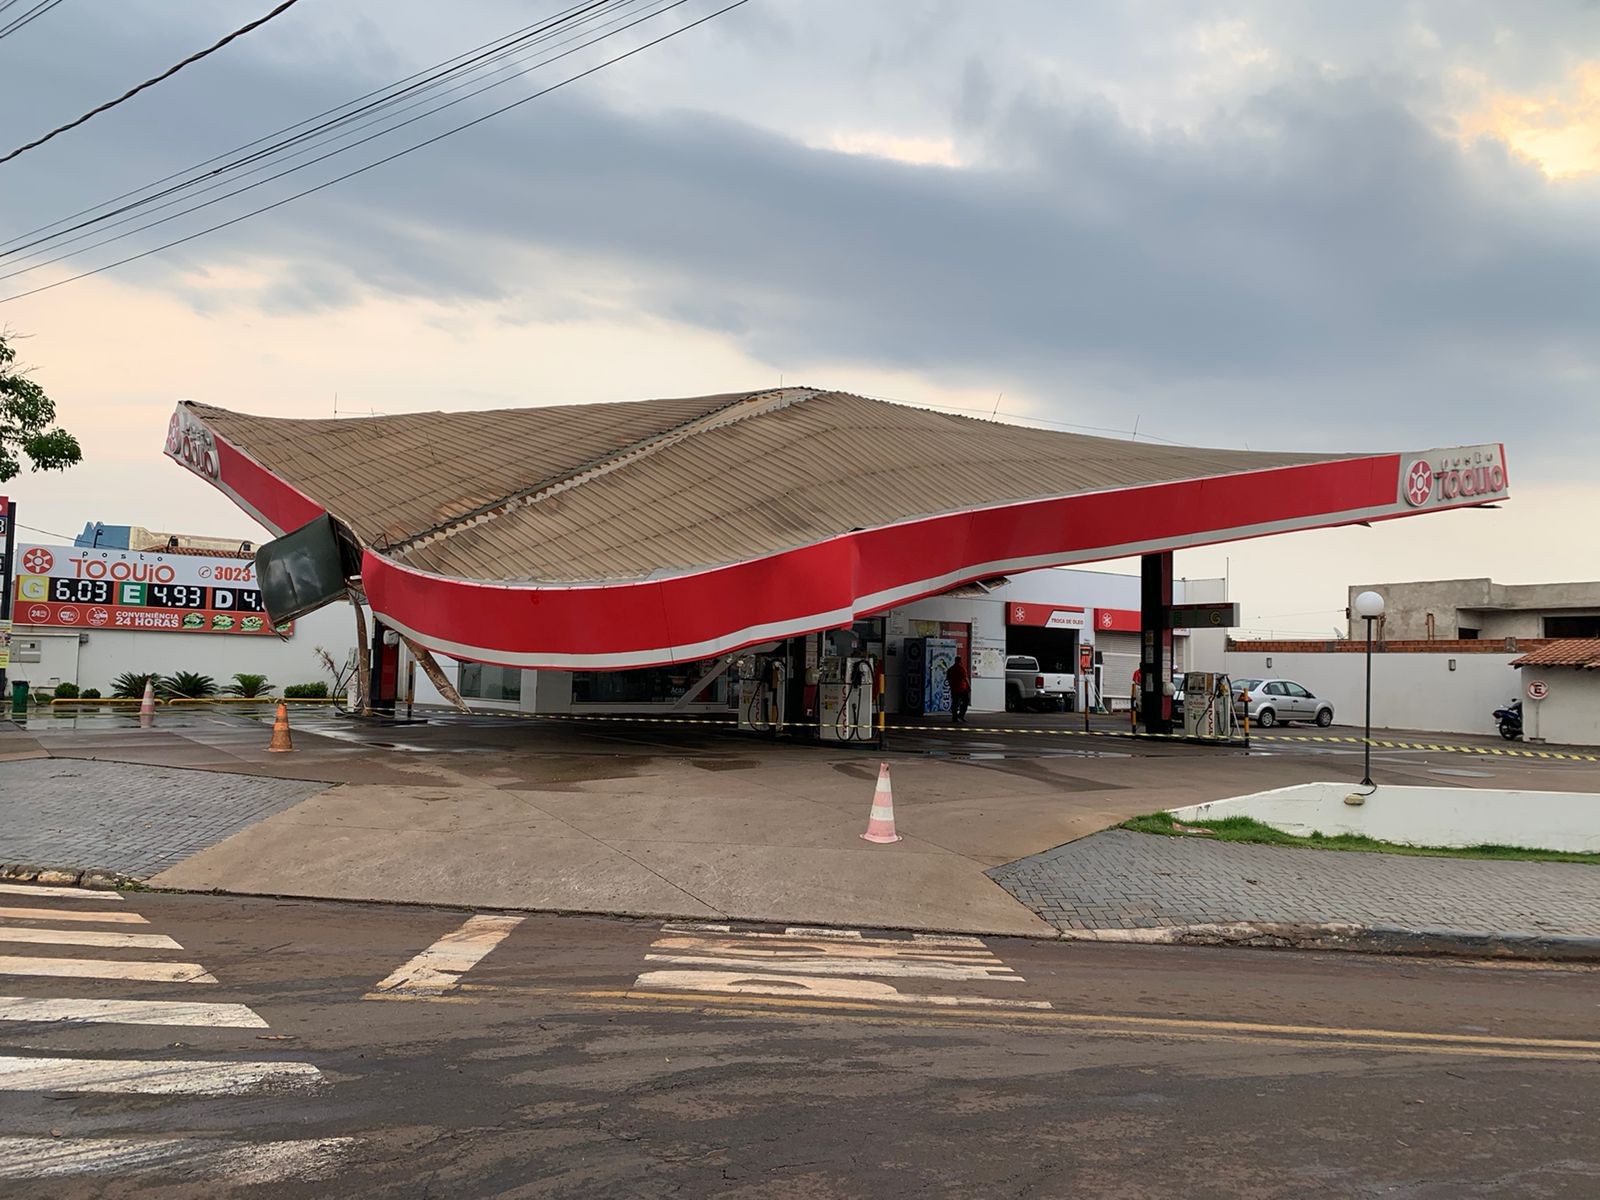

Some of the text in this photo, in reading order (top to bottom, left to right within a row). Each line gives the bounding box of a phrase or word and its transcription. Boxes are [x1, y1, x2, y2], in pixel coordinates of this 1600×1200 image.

[22, 579, 107, 602] G 6.03
[123, 584, 201, 607] E 4.93
[215, 589, 265, 611] D 4.
[115, 617, 131, 626] 24
[135, 618, 179, 628] HORAS
[1534, 684, 1542, 694] E
